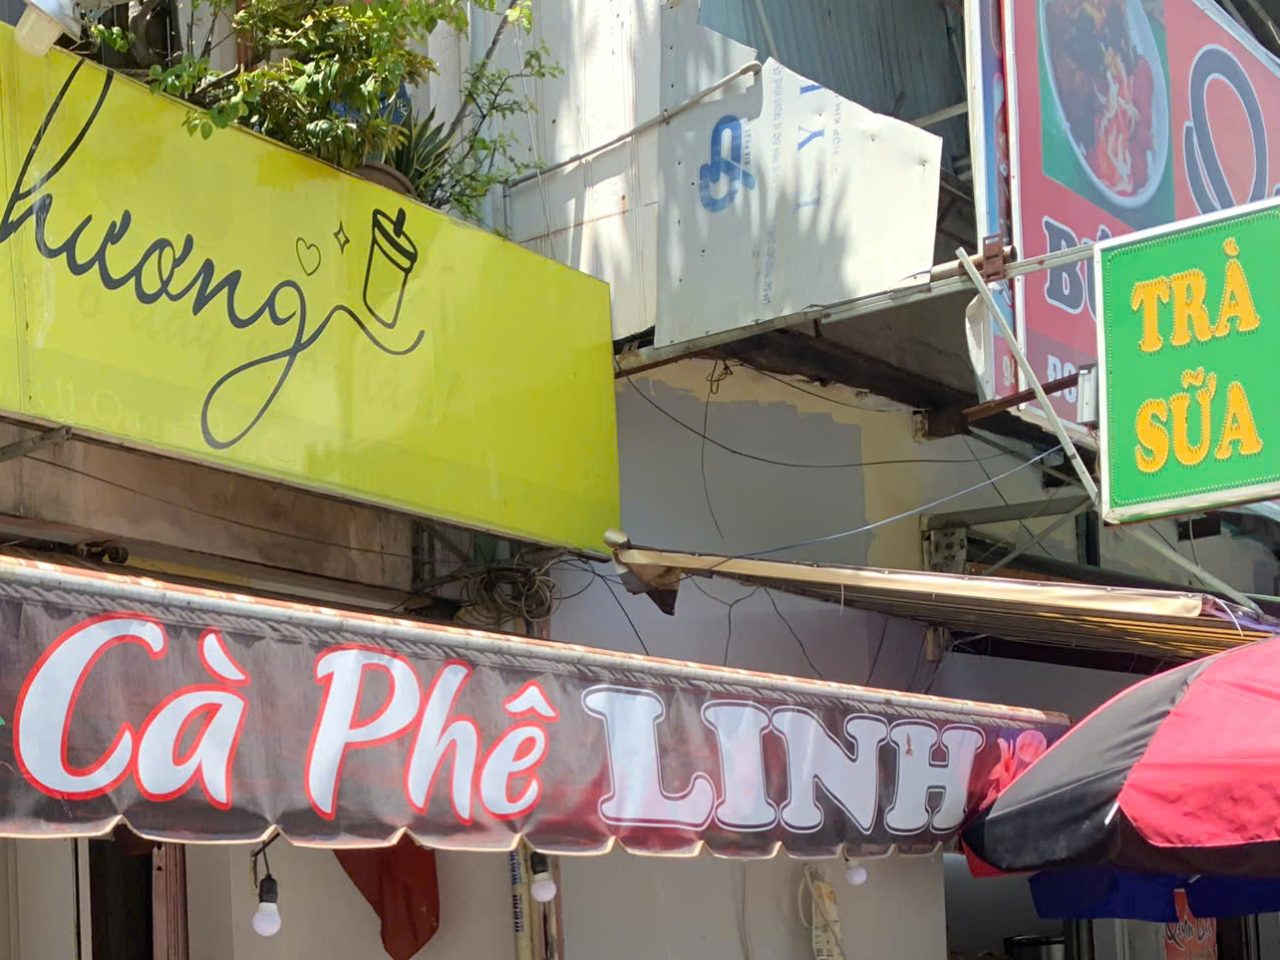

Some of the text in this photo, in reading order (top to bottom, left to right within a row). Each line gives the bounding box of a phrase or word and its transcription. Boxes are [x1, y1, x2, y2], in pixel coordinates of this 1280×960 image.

[1130, 236, 1261, 353] TRÀ
[1134, 366, 1264, 474] SỮA
[14, 613, 986, 835] Cà Phê LINH
